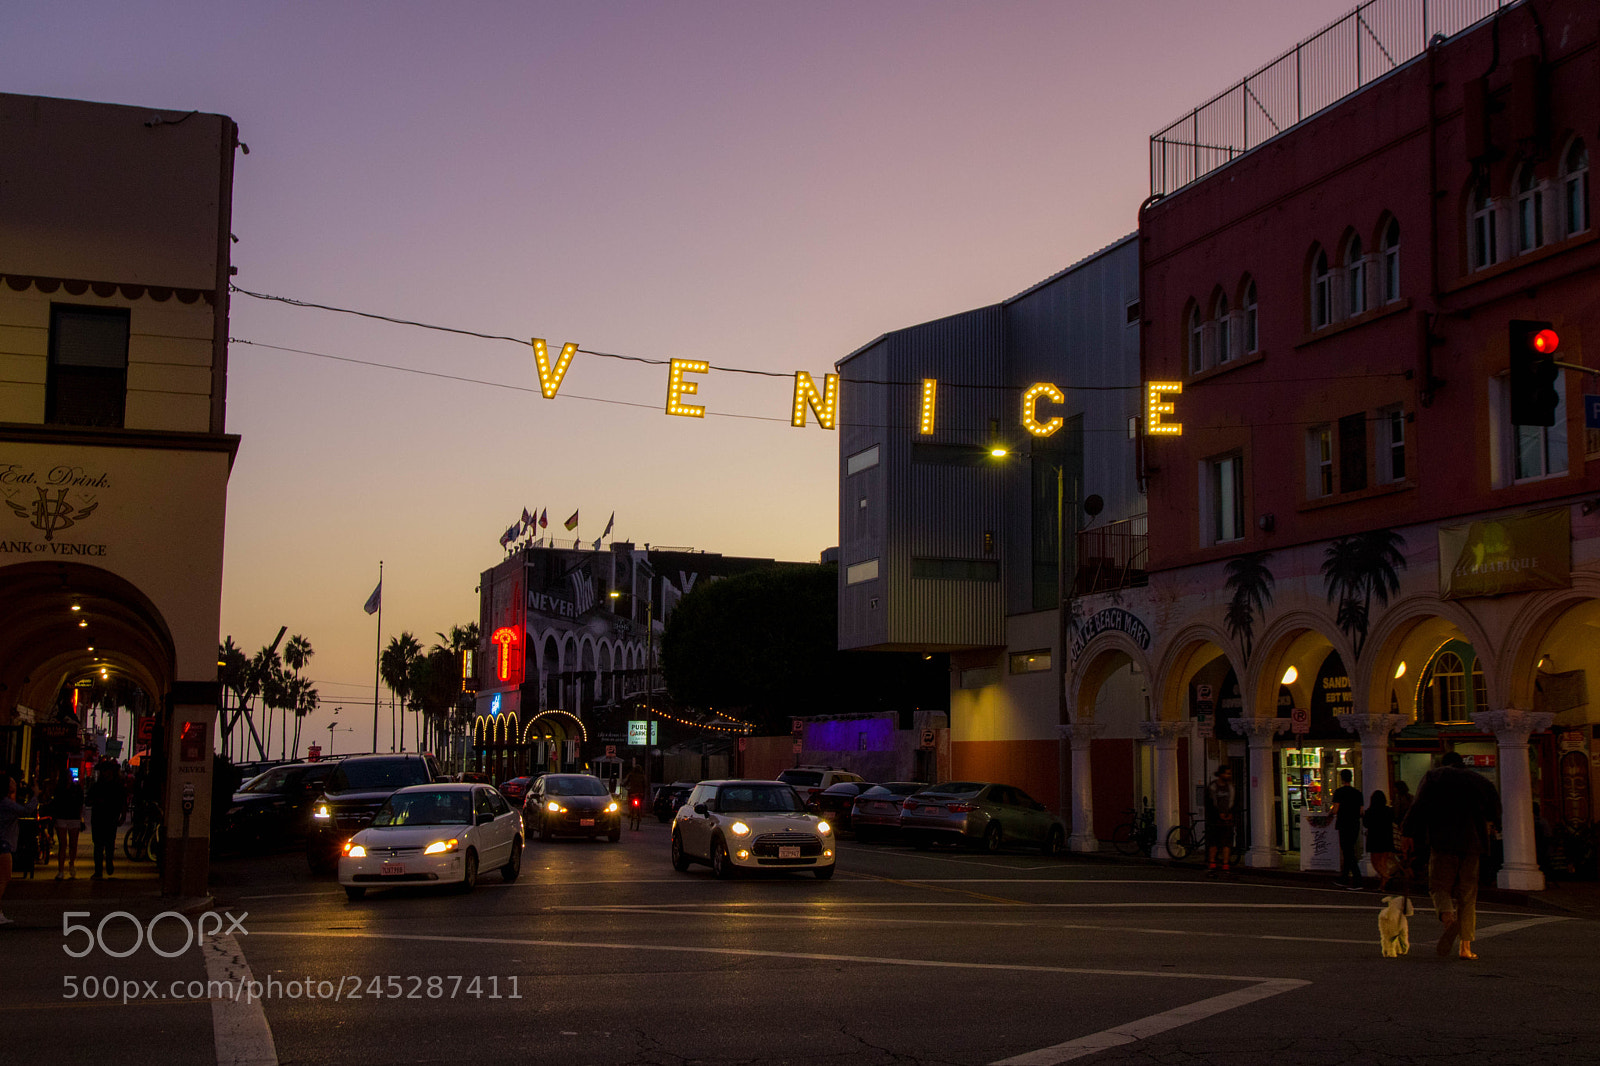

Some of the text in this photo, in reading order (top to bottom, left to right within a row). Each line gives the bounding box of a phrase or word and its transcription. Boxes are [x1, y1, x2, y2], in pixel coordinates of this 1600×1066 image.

[531, 338, 1183, 438] VENICE
[0, 464, 111, 488] Eat. Drink.
[50, 543, 107, 556] VENICE
[1094, 608, 1122, 632] BEACH
[1123, 613, 1149, 649] MART
